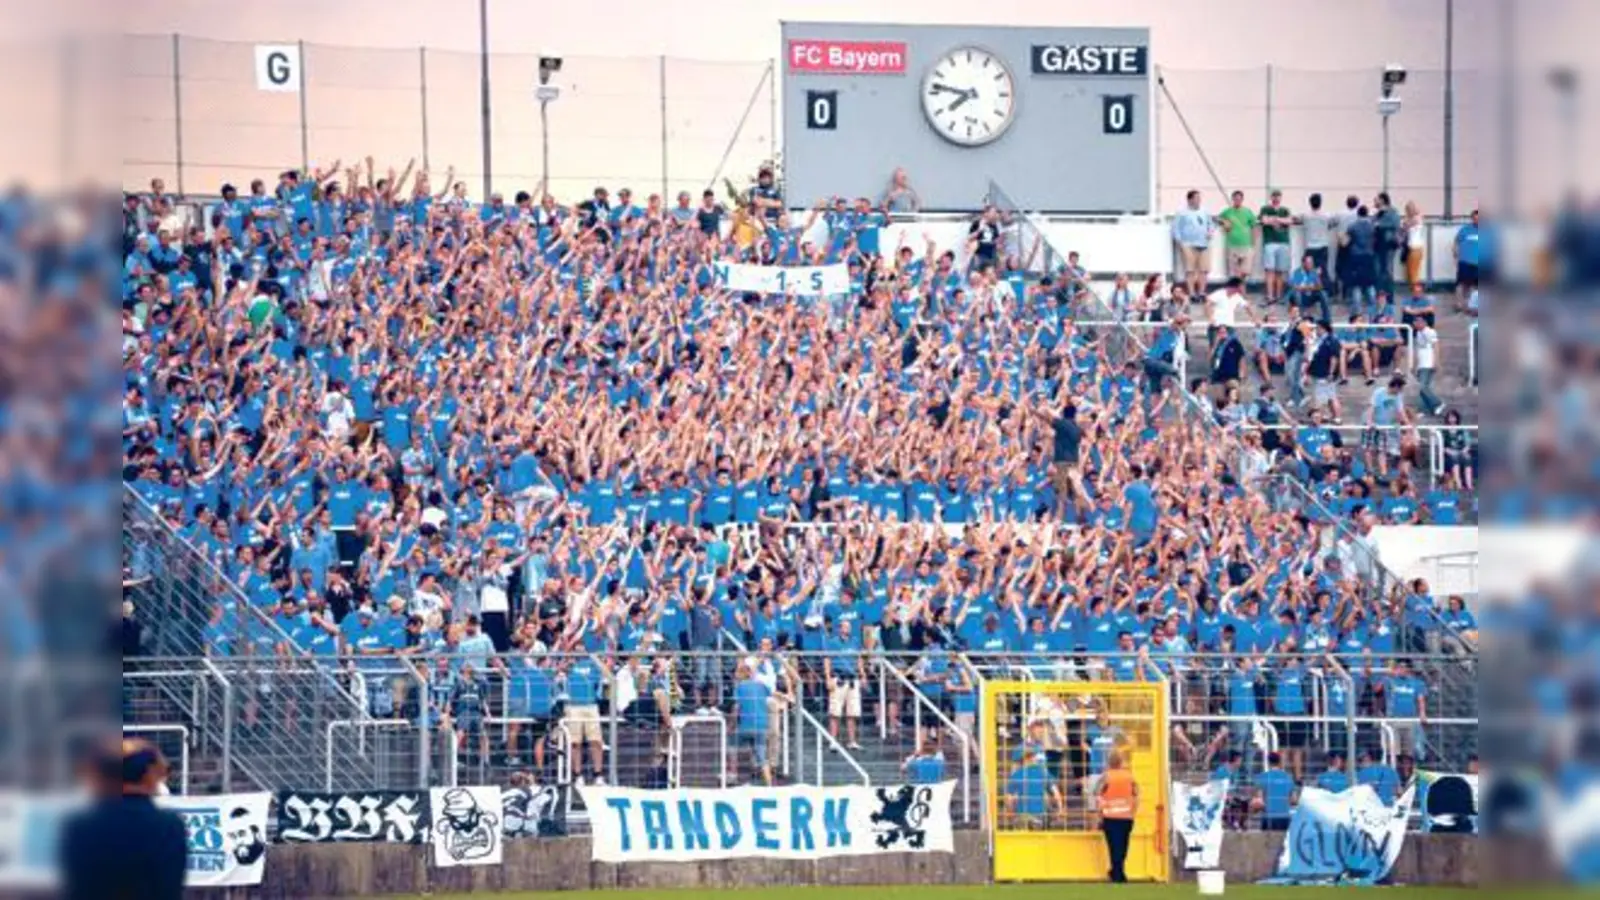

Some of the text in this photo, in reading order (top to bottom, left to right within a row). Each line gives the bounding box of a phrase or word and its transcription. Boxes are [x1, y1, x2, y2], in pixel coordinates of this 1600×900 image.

[267, 52, 290, 85] G
[793, 45, 901, 72] FC Bayern
[1041, 43, 1138, 72] GÄSTE
[814, 98, 831, 125] 0
[1108, 102, 1126, 129] 0
[606, 796, 852, 852] TANDERN
